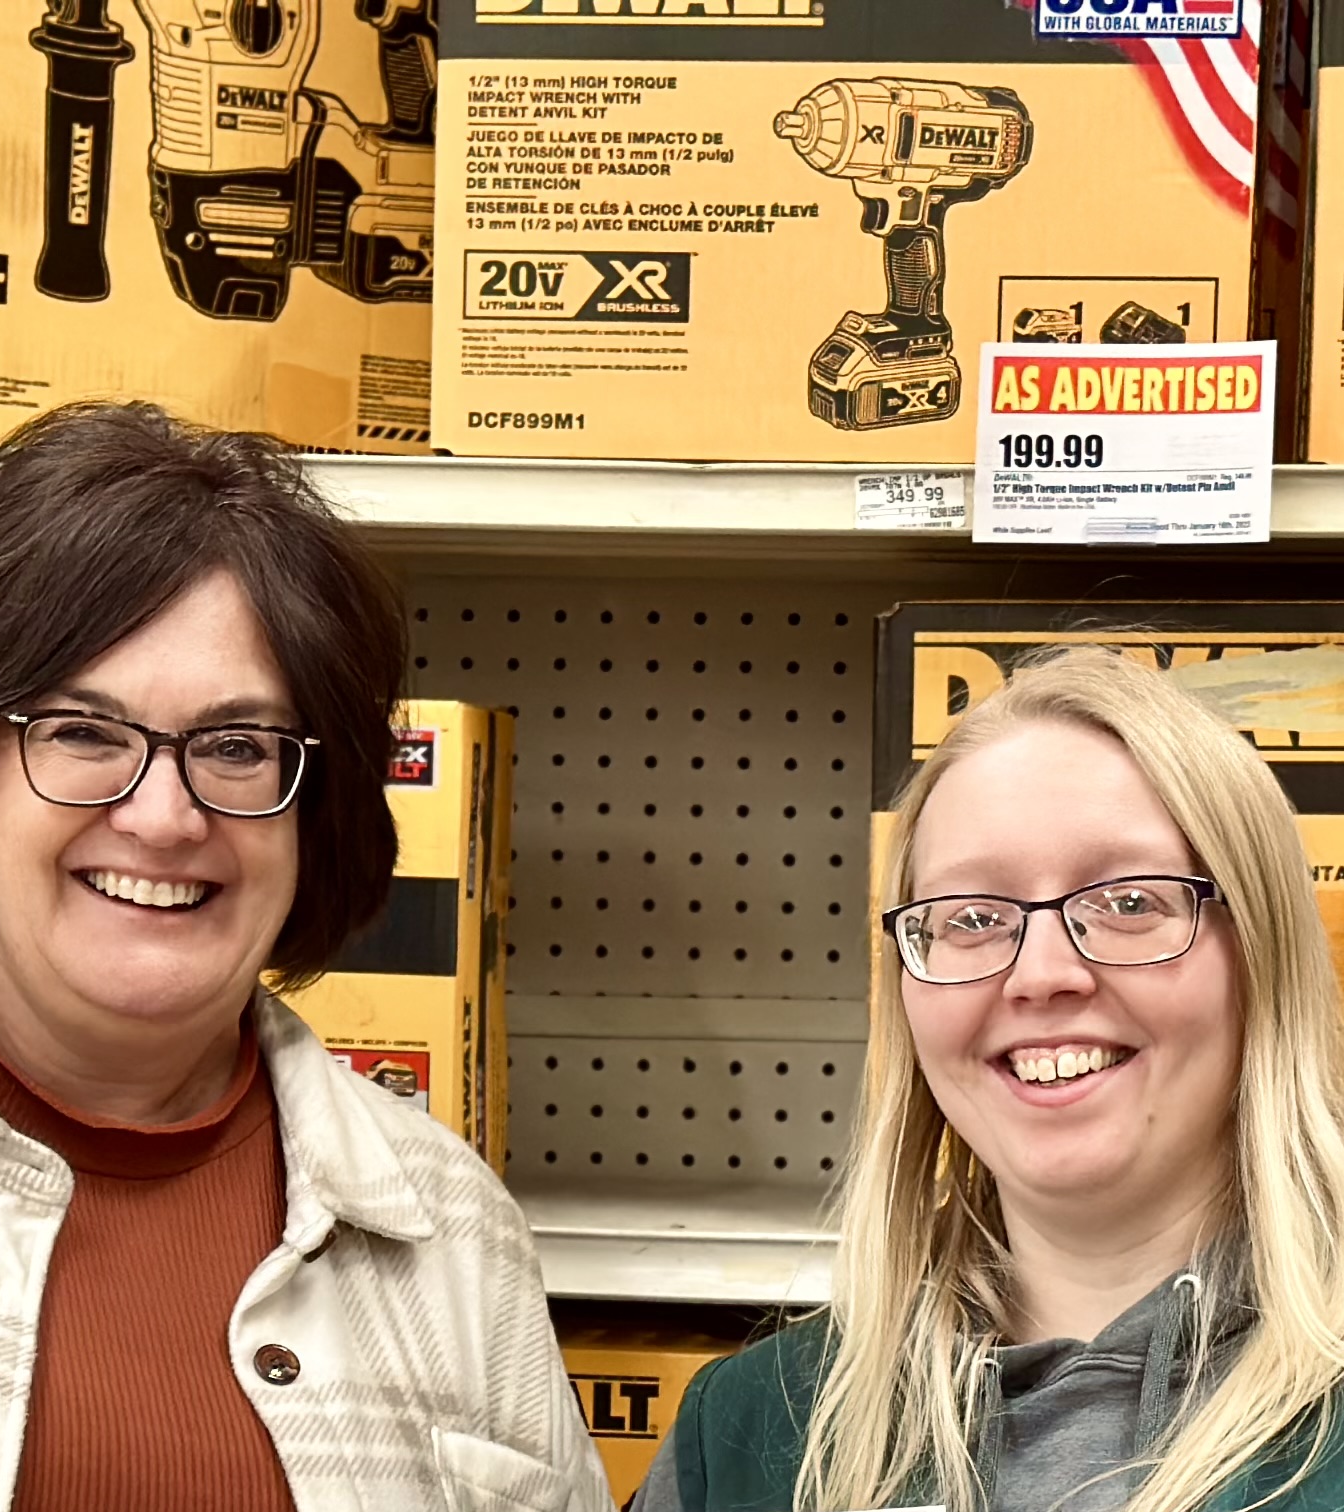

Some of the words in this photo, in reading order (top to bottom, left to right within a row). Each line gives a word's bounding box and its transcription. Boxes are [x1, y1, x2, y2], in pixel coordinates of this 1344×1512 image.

[1044, 16, 1081, 31] WITH
[1086, 16, 1140, 31] GLOBAL
[1145, 17, 1228, 32] MATERIALS
[505, 76, 529, 90] (13
[533, 77, 566, 91] mm)
[570, 77, 608, 90] HIGH
[613, 77, 677, 91] TORQUE
[468, 92, 525, 104] IMPACT
[530, 92, 597, 105] WRENCH
[602, 93, 641, 105] WITH
[468, 107, 528, 119] DETENT
[533, 107, 578, 119] ANVIL
[582, 108, 607, 119] KIT
[920, 126, 998, 148] DEWALT
[604, 261, 671, 300] XR
[597, 303, 680, 314] BRUSHLESS
[995, 365, 1040, 412] AS
[1049, 365, 1258, 412] ADVERTISED
[468, 412, 586, 430] DCF899M1
[998, 434, 1104, 469] 199.99
[886, 486, 944, 504] 349.99
